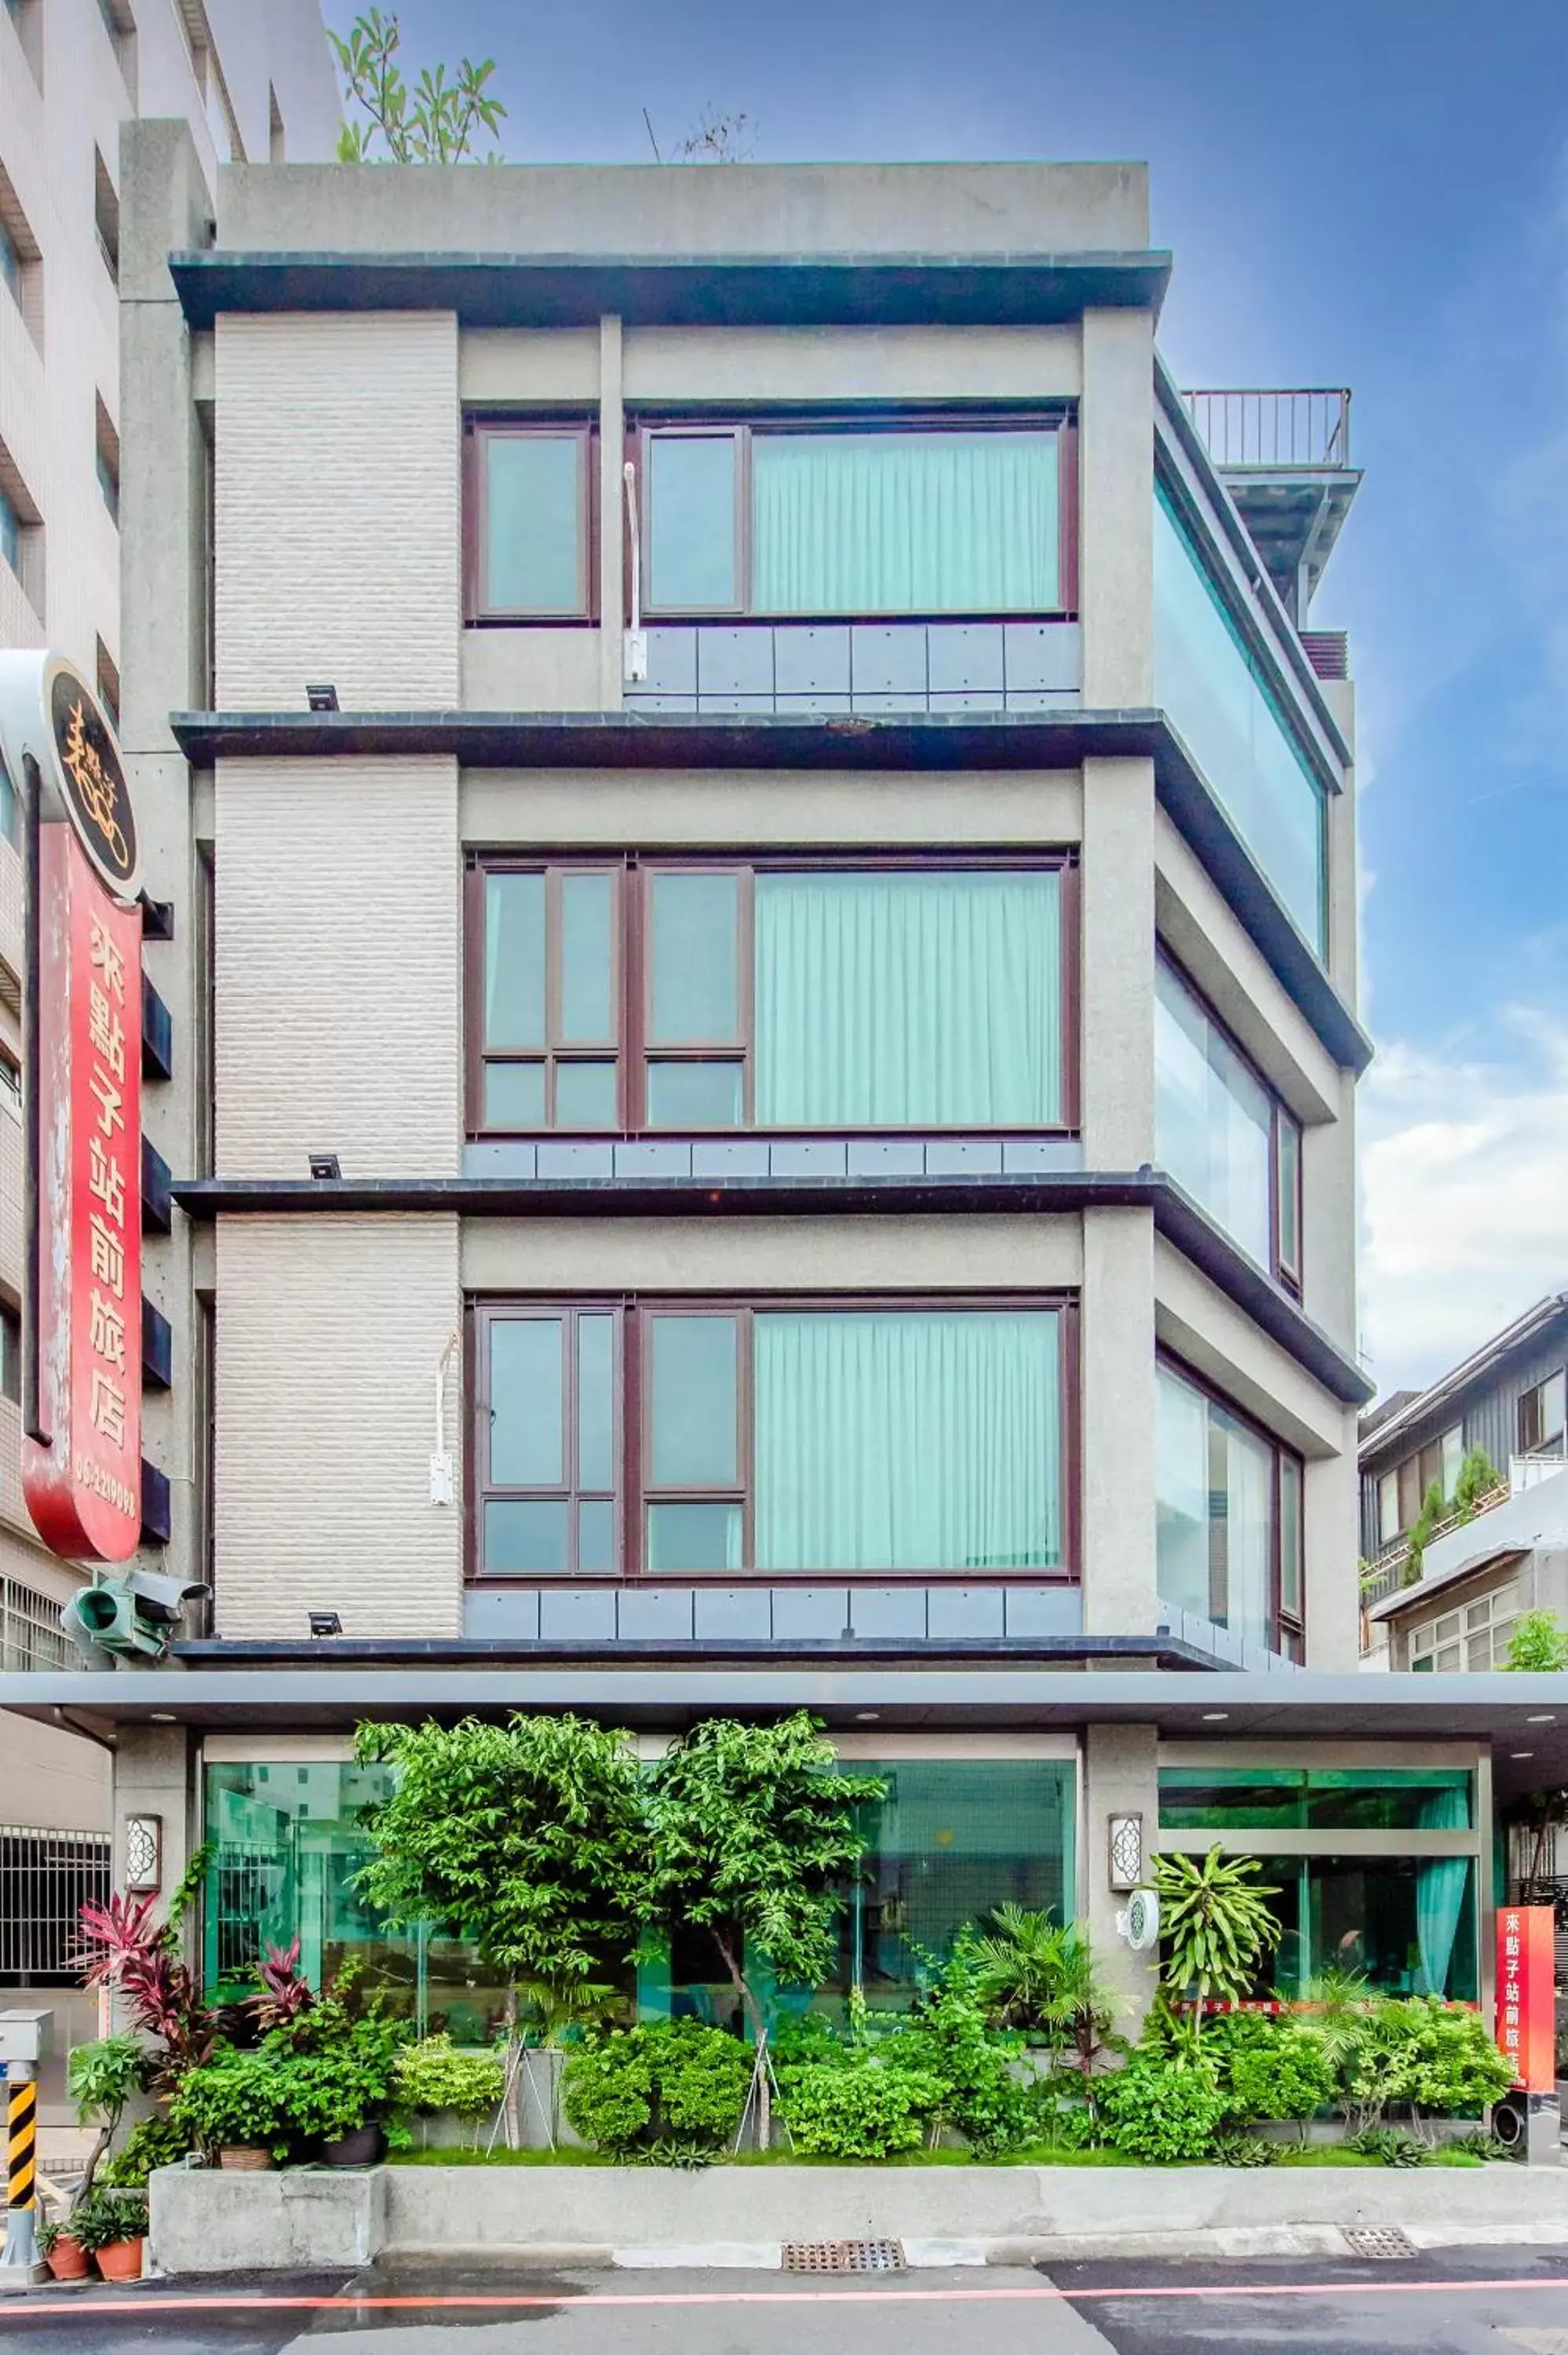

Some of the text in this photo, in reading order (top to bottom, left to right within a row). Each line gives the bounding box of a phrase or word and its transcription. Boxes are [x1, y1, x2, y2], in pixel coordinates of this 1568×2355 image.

[89, 907, 126, 1450] 來點子站前旅店
